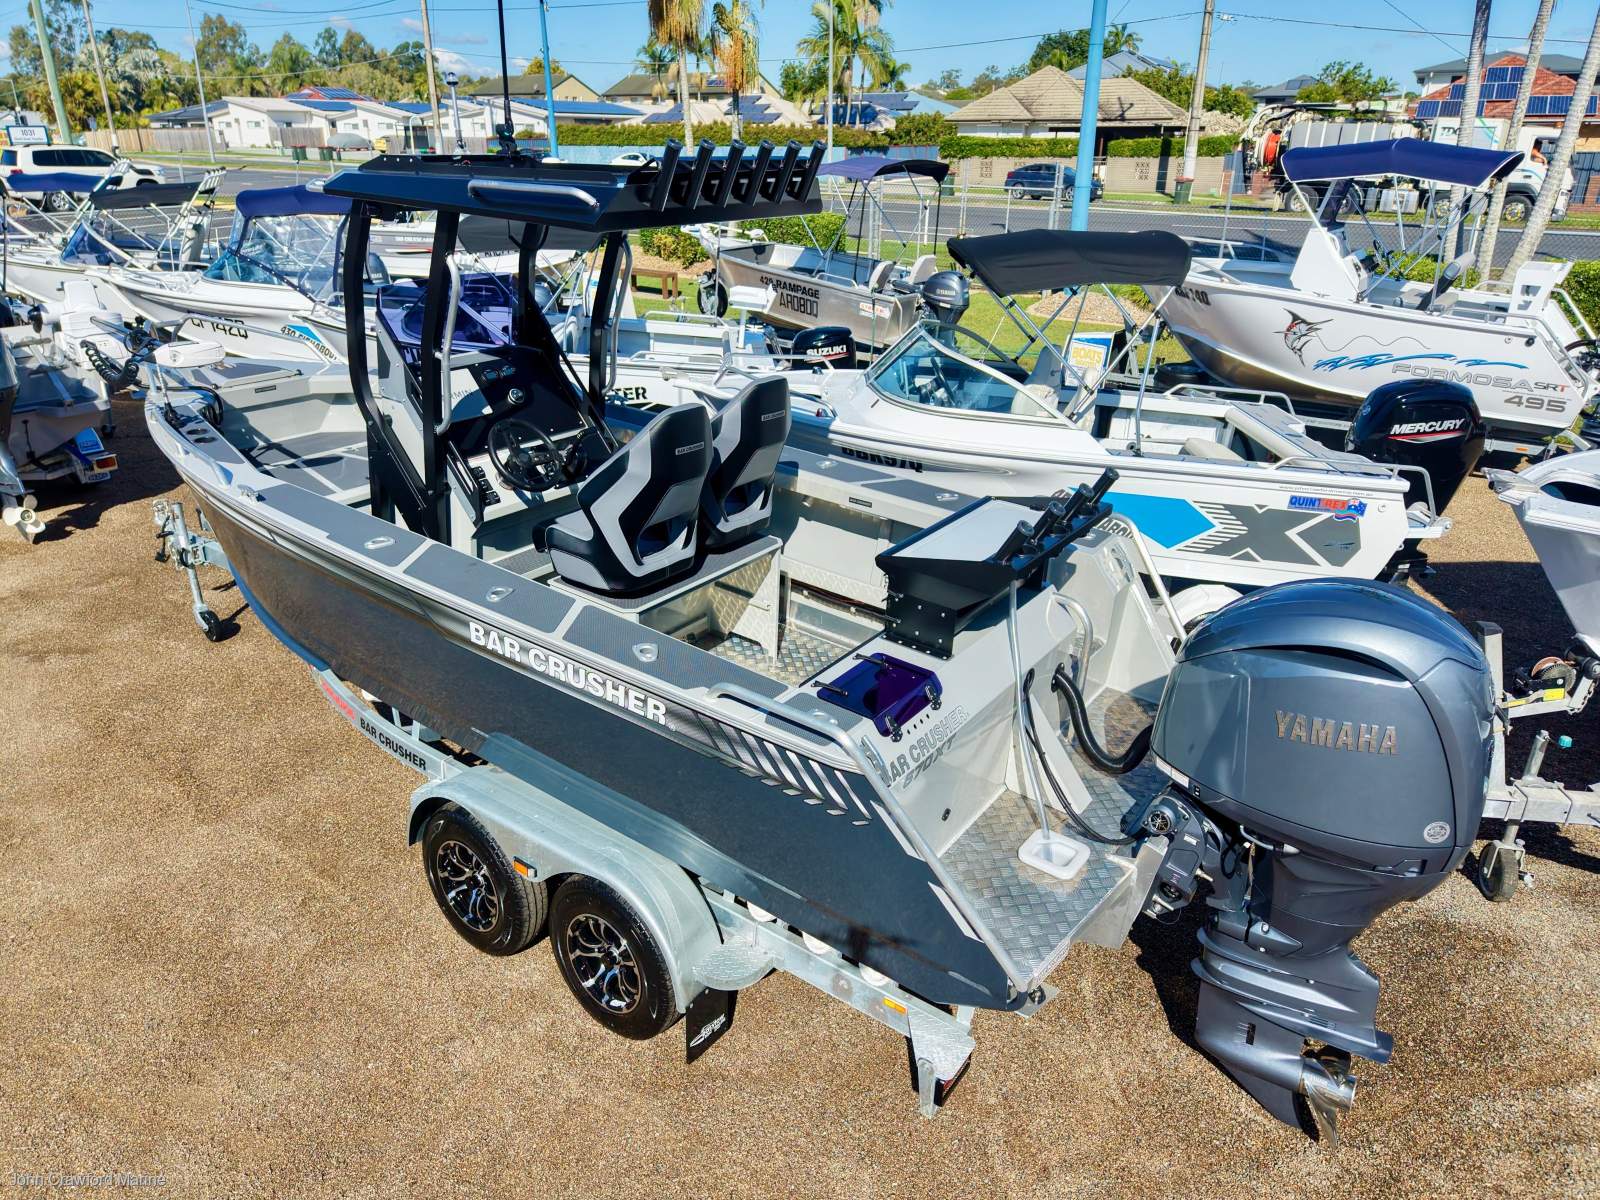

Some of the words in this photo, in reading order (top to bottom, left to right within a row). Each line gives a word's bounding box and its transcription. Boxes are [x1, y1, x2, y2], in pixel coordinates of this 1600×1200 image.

[776, 279, 820, 300] RAMPAGE
[806, 344, 847, 357] SUZUKI
[1392, 363, 1533, 392] FORMOSA
[1533, 382, 1568, 393] SRT
[1504, 395, 1567, 413] 495
[1390, 418, 1465, 435] MERCURY
[469, 621, 521, 663] BAR
[528, 648, 667, 726] CRUSHER
[360, 716, 377, 739] BAR
[378, 732, 426, 771] CRUSHER
[890, 753, 911, 783] AR
[908, 705, 968, 763] CRUSHER
[1275, 710, 1400, 756] YAMAHA
